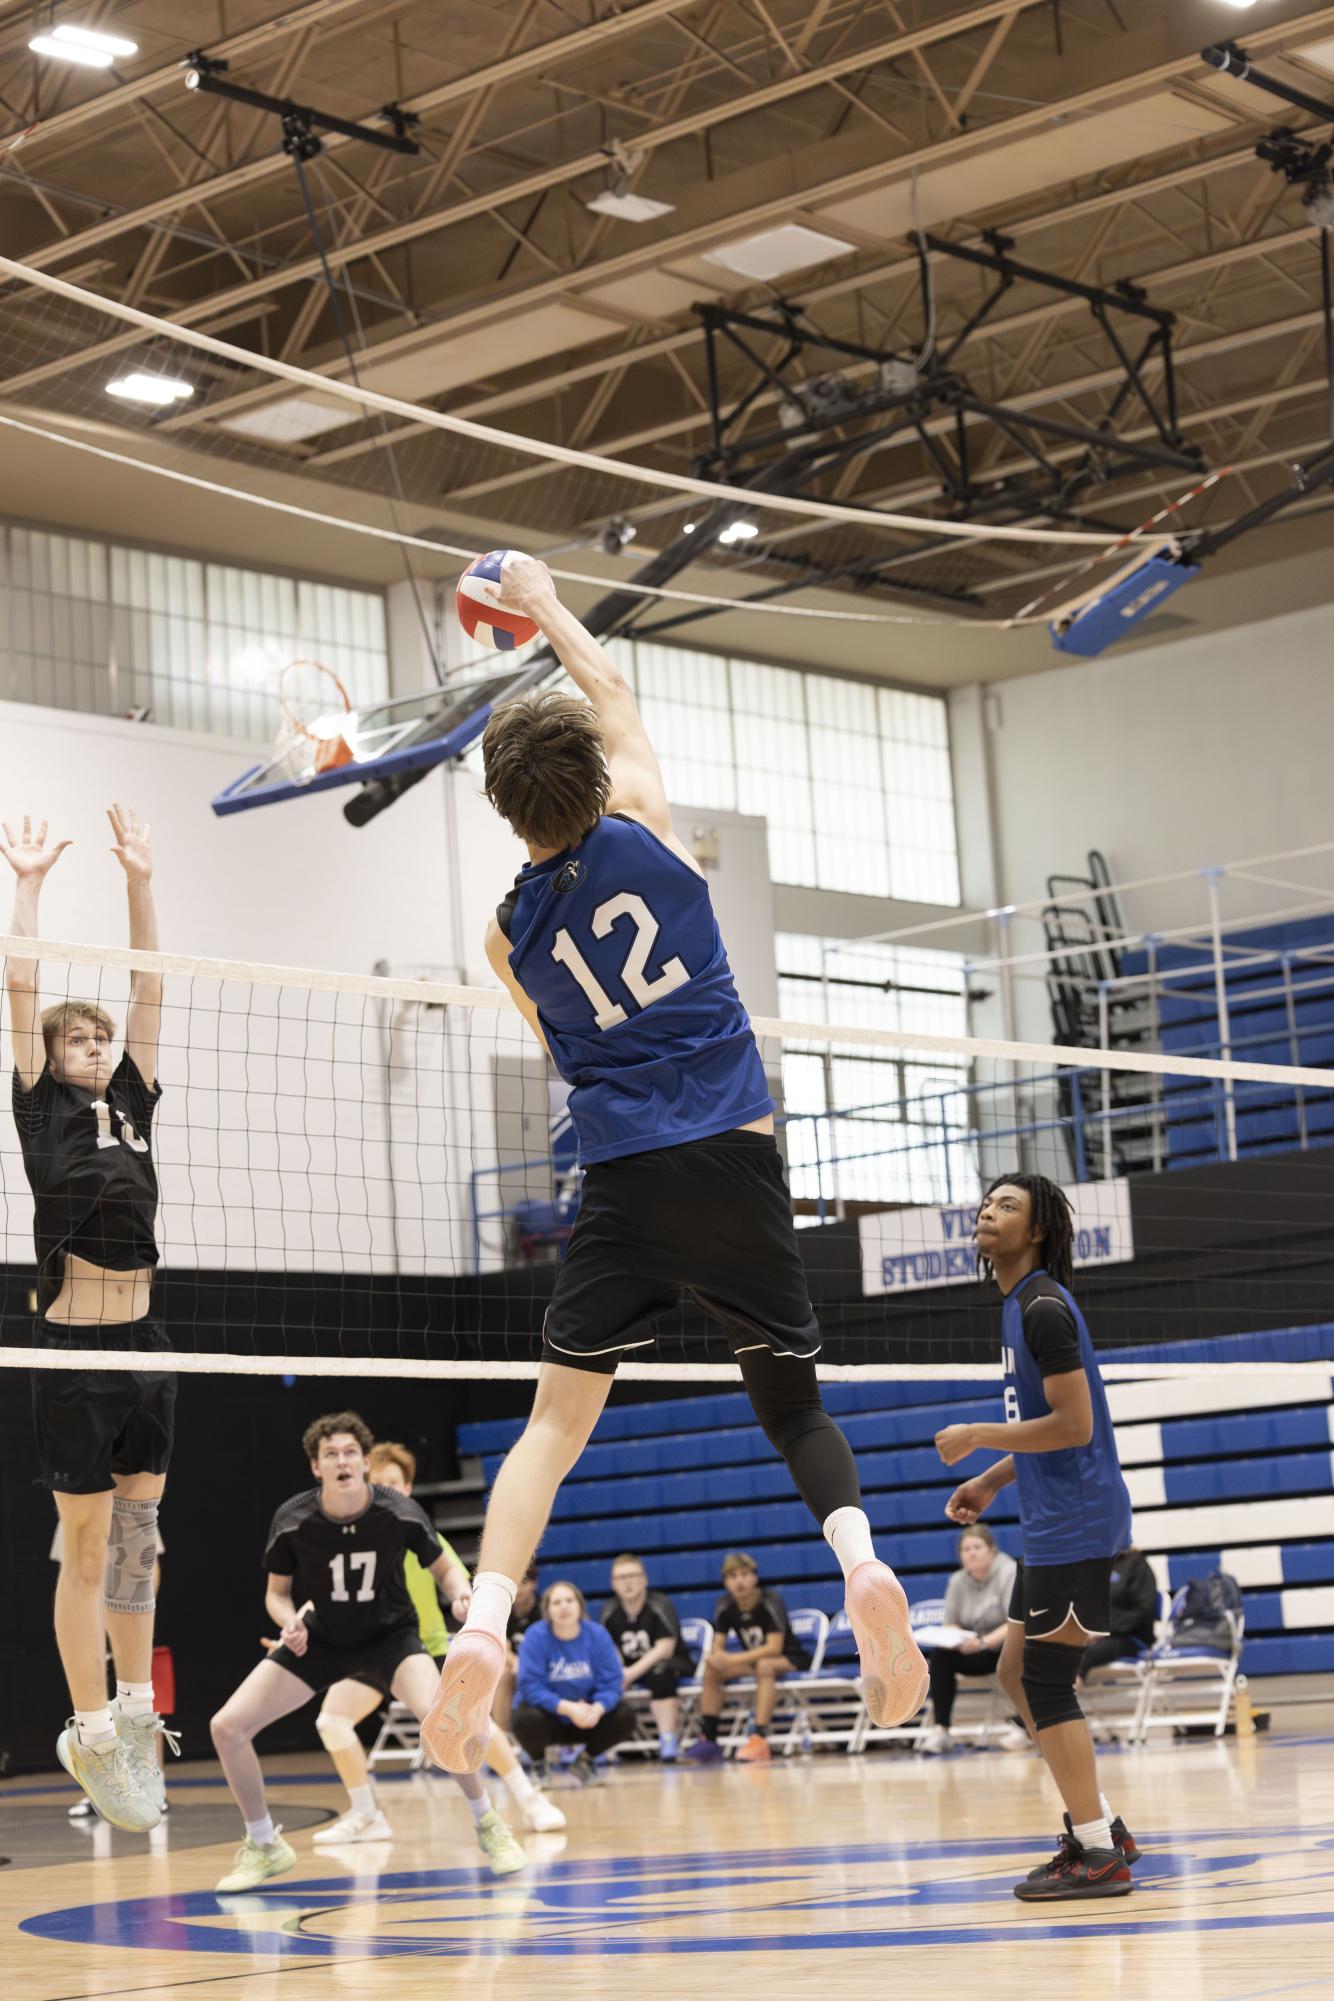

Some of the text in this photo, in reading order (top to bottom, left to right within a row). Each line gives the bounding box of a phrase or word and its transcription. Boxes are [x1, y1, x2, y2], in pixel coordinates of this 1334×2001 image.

[550, 889, 692, 1032] 12
[940, 1207, 978, 1239] VIS
[882, 1245, 978, 1286] STUDEN
[328, 1550, 377, 1602] 17
